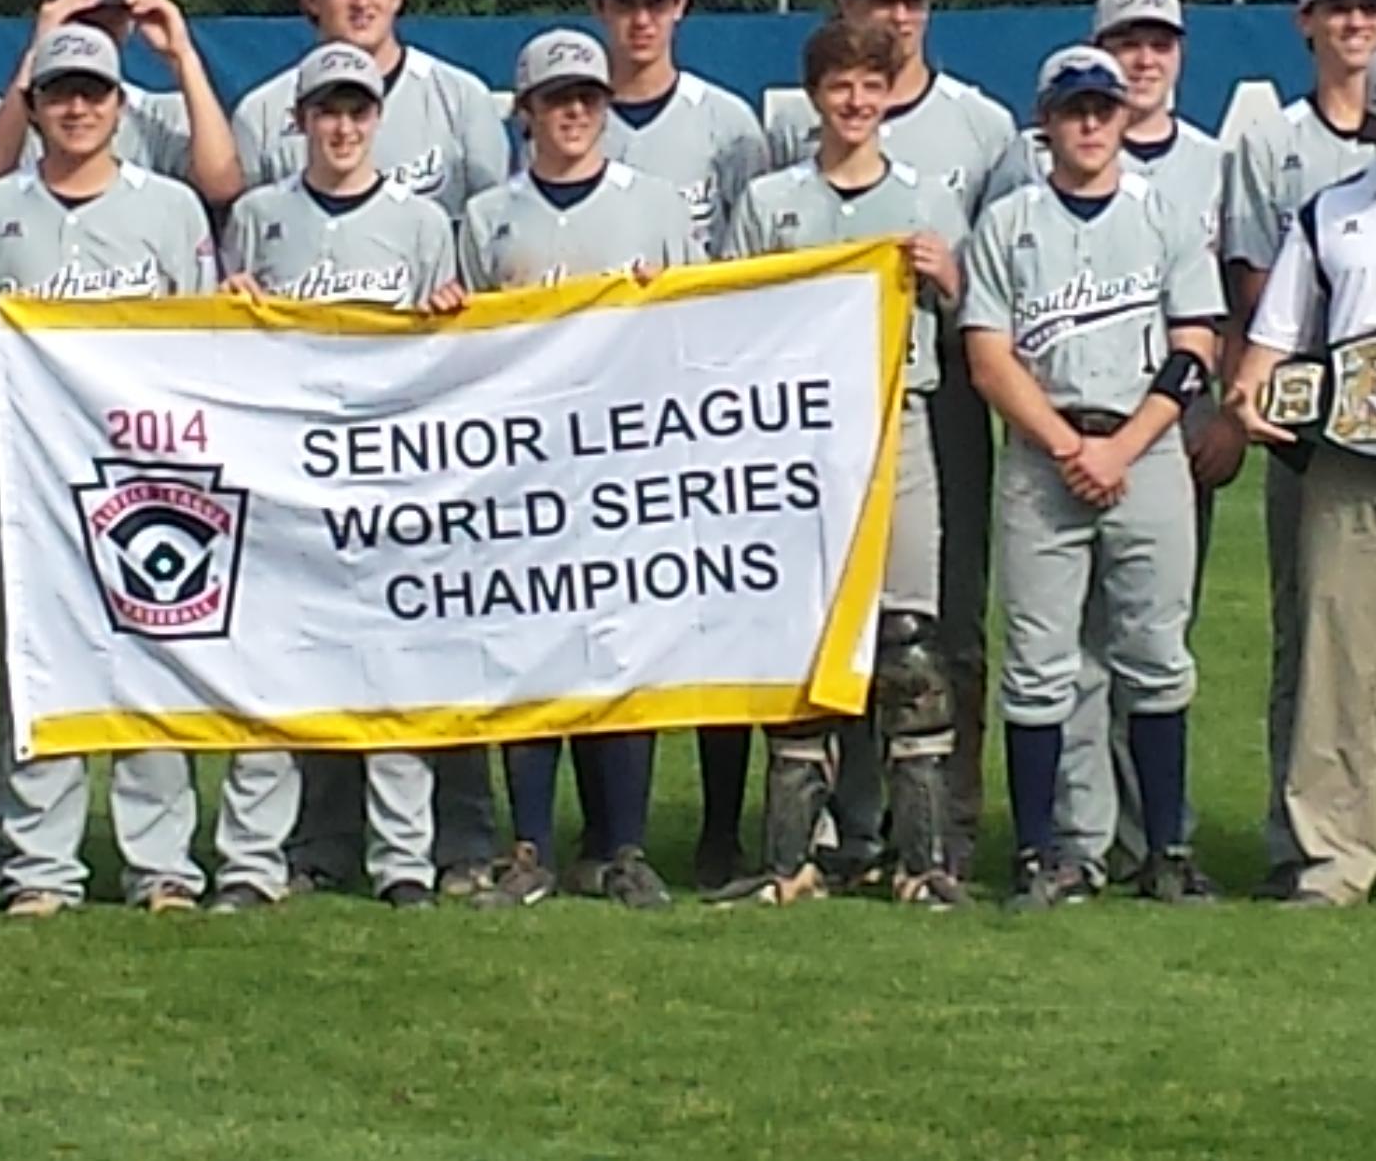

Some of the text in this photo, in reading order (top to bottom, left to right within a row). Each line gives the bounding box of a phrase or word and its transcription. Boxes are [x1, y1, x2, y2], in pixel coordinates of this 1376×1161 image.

[1139, 322, 1158, 376] 1
[107, 409, 208, 452] 2014
[304, 380, 832, 478] SENIOR LEAGUE
[322, 462, 820, 550] WORLD SERIES
[386, 543, 778, 620] CHAMPIONS
